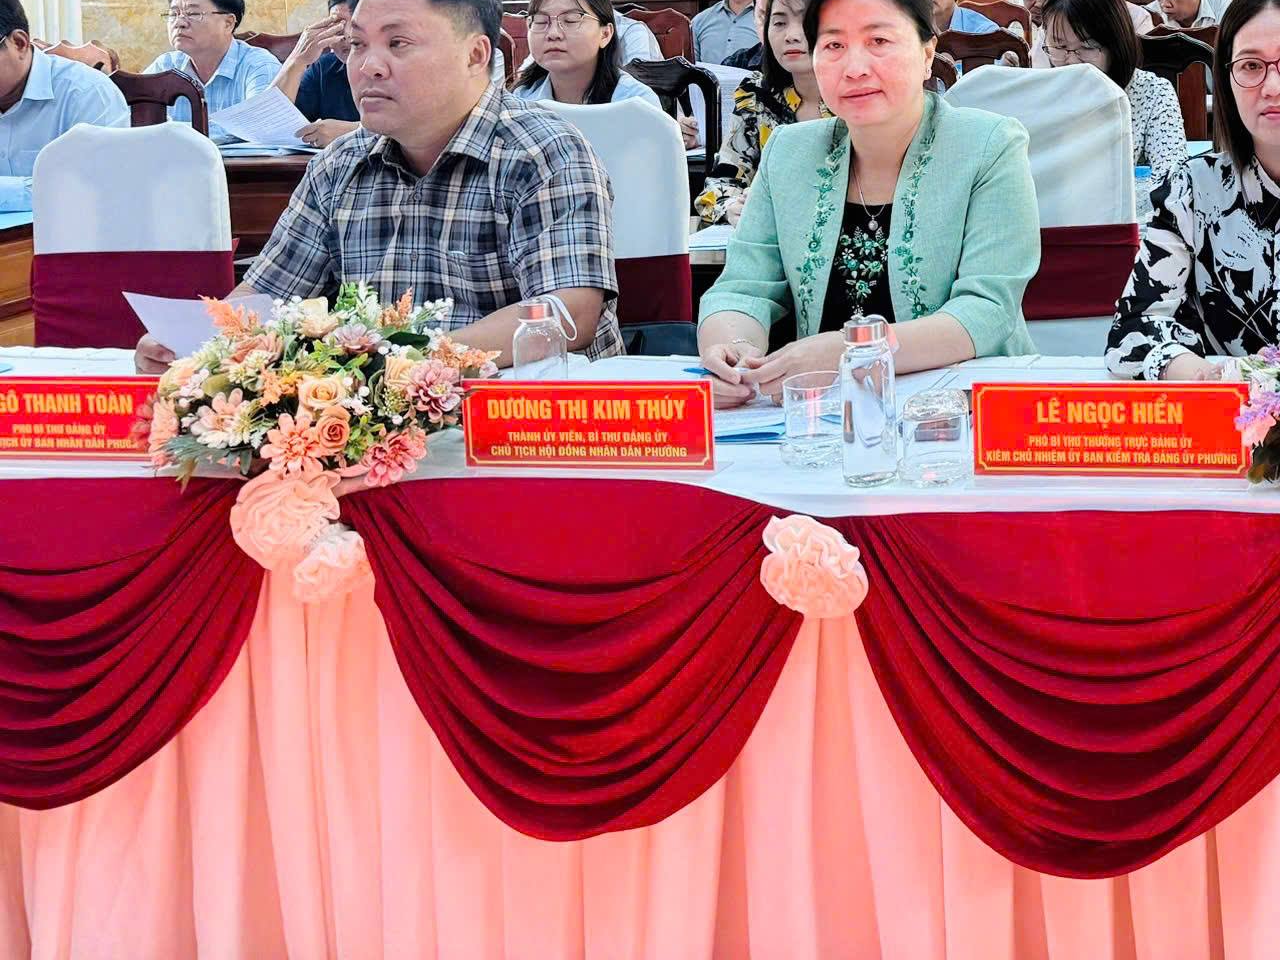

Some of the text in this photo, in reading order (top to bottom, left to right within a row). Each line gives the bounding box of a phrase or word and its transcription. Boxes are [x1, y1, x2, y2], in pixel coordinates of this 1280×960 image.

[24, 393, 81, 413] THANH
[86, 391, 133, 414] TOÀN
[487, 395, 686, 424] DƯƠNG THỊ KIM THÚY
[1036, 397, 1059, 424] LÊ
[1066, 401, 1126, 429] NGỌC
